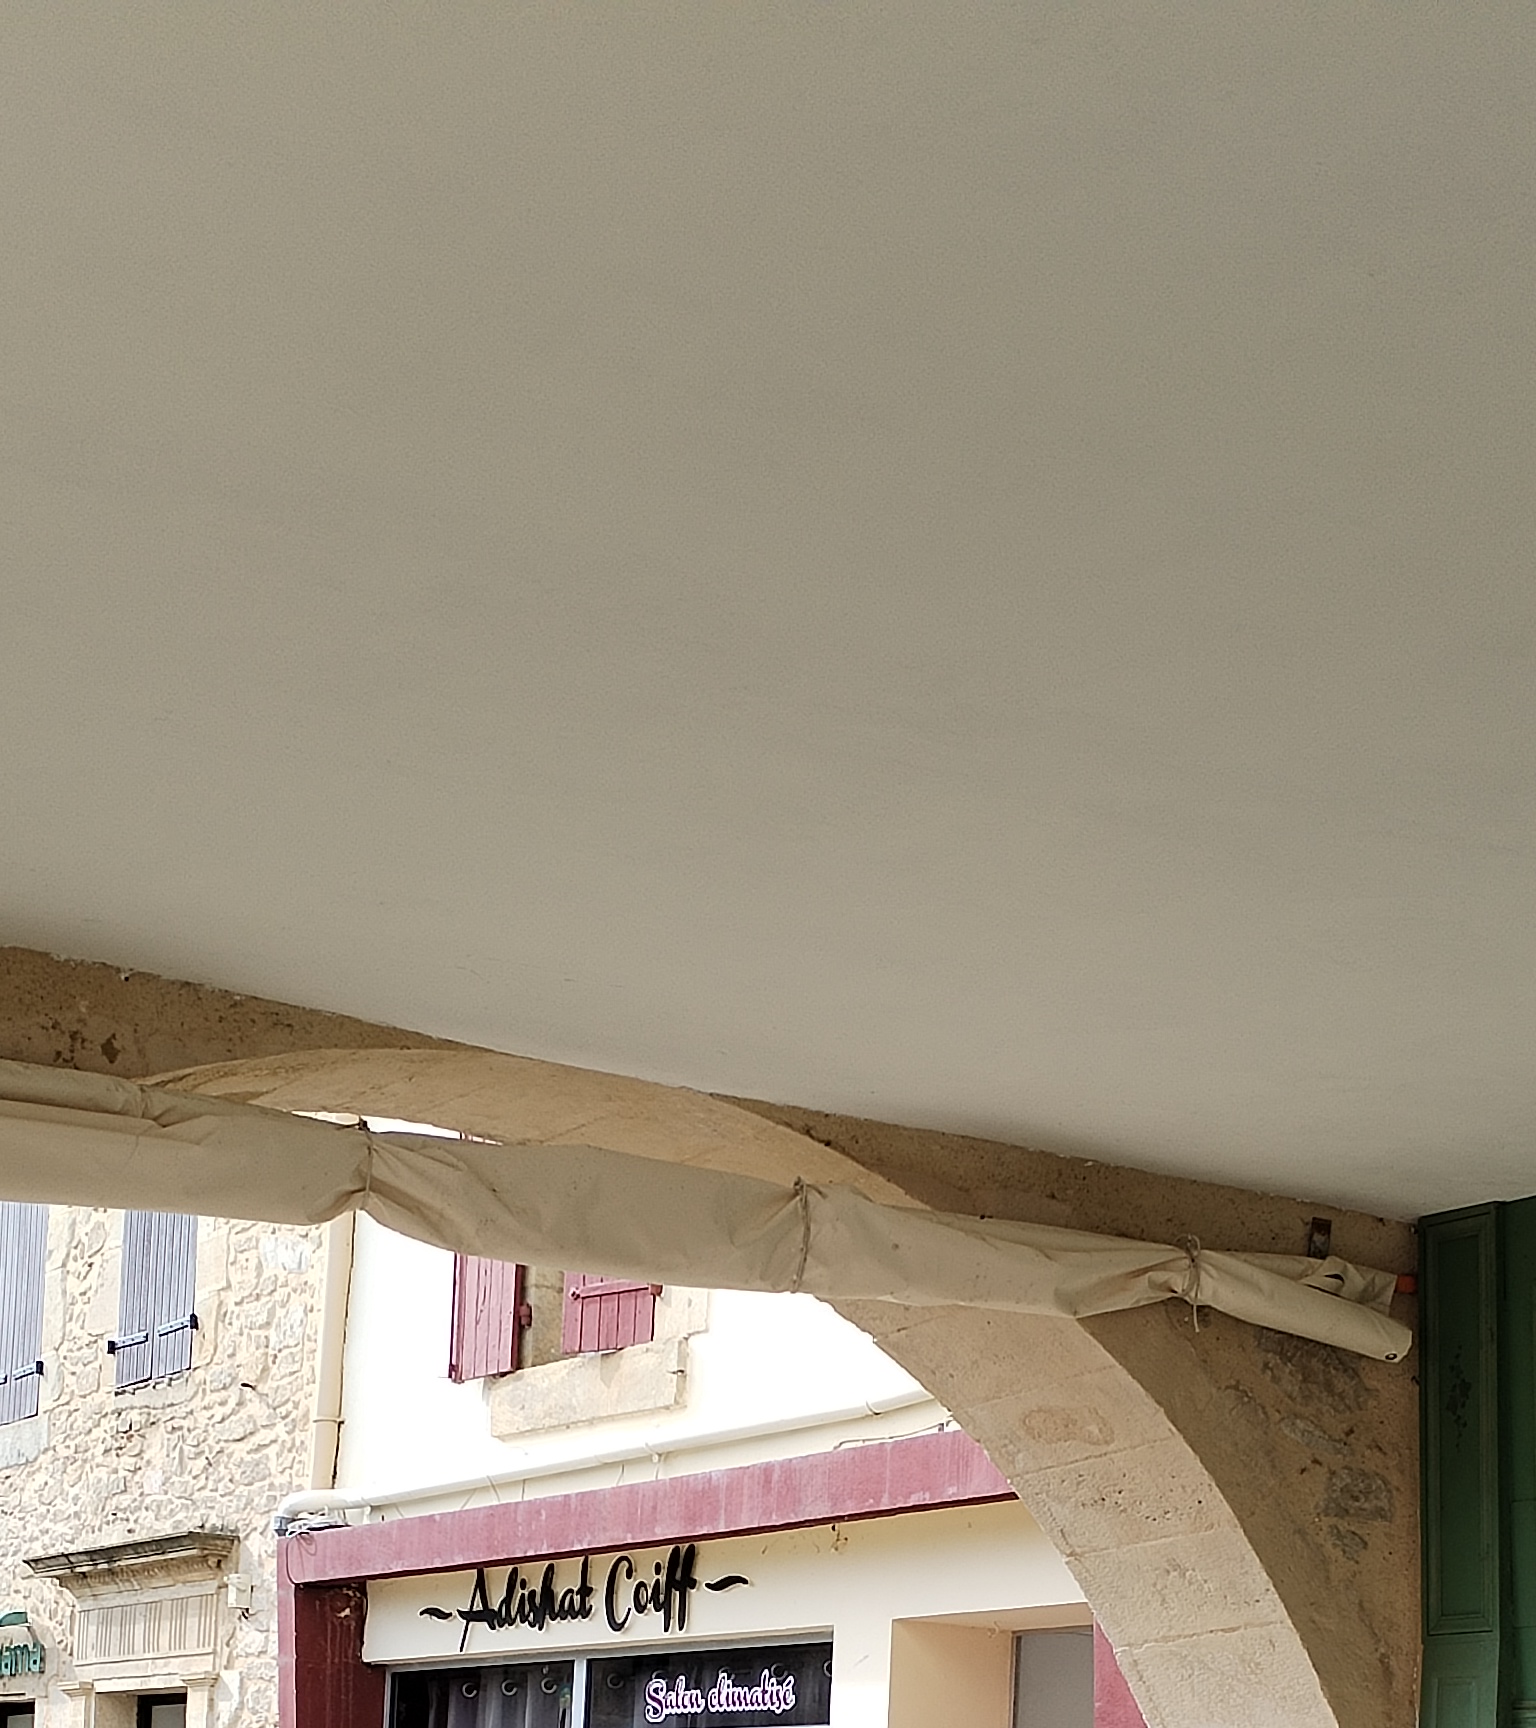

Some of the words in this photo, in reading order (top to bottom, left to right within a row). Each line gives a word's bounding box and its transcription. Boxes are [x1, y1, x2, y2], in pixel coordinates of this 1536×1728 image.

[456, 1555, 594, 1653] Adishat
[603, 1543, 698, 1633] Coiff
[645, 1675, 706, 1723] Salon
[707, 1668, 796, 1715] climatisé
